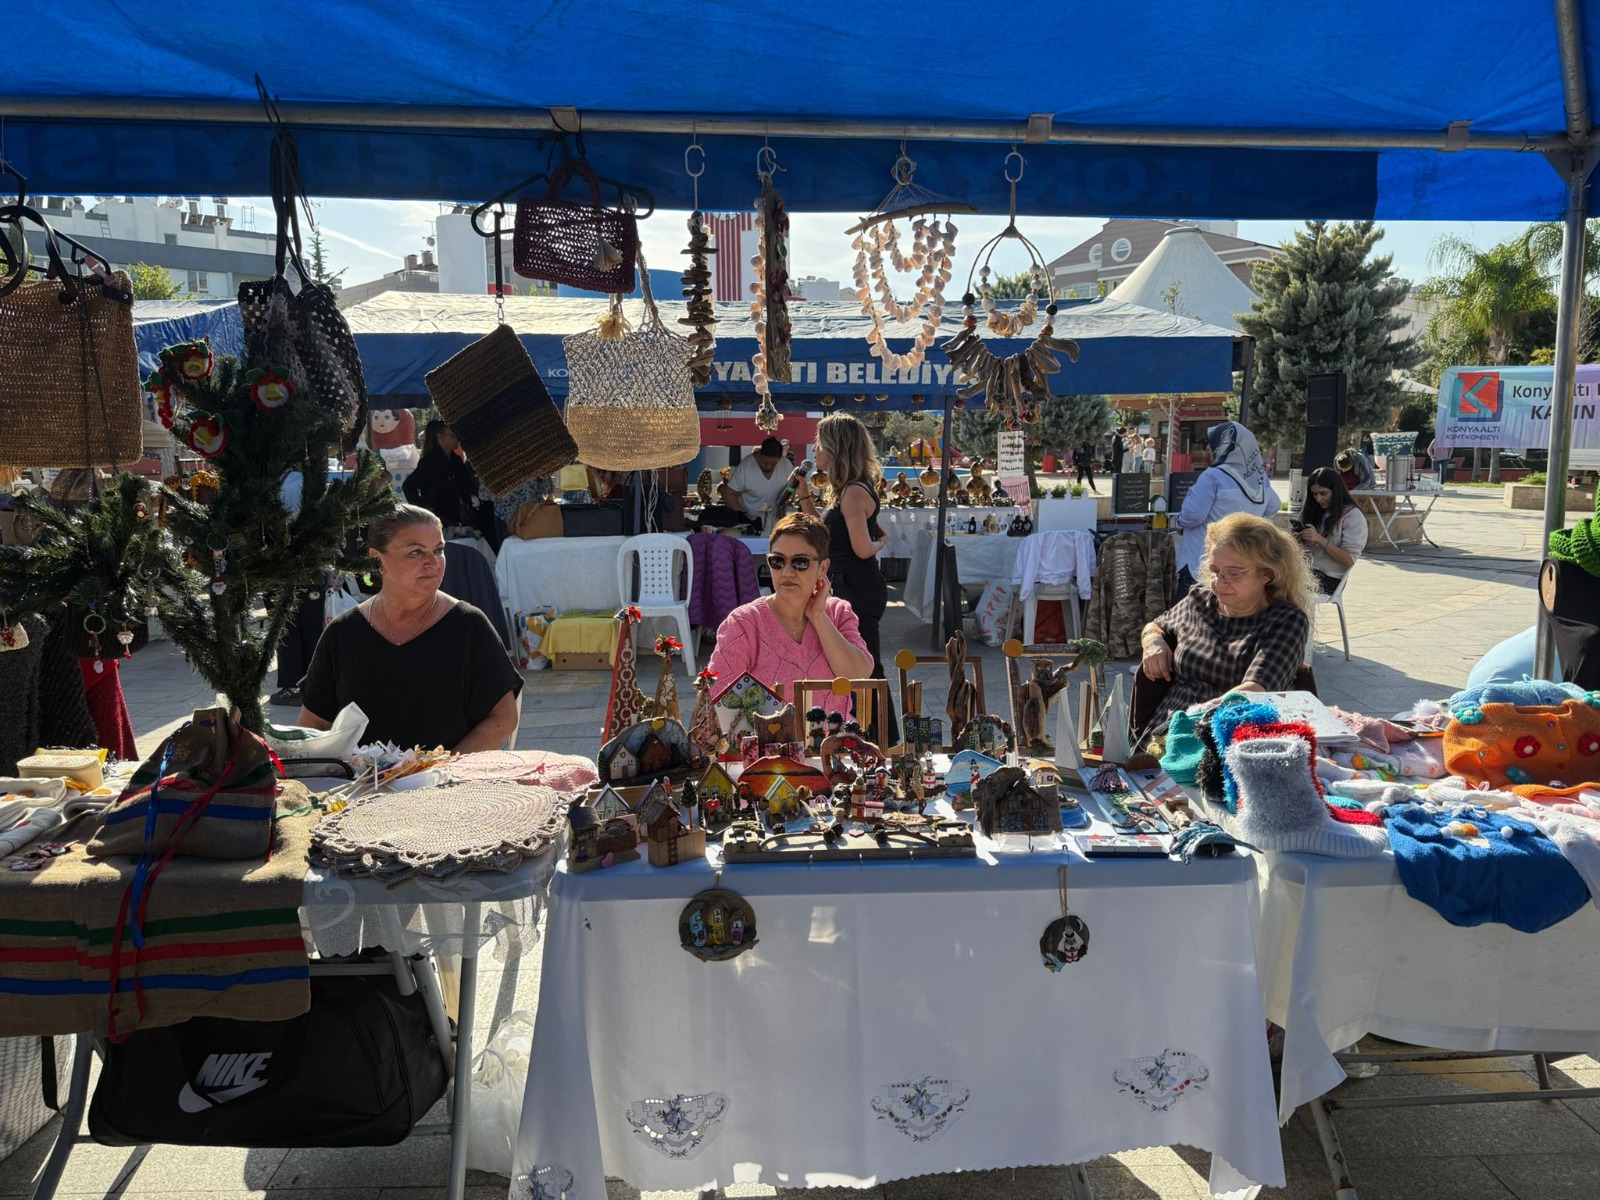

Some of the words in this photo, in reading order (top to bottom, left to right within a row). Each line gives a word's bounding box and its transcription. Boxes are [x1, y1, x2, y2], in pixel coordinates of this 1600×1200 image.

[547, 367, 569, 378] KO
[1512, 383, 1590, 401] Konyltı
[1530, 404, 1596, 420] KAIN
[195, 1052, 273, 1087] NIKE
